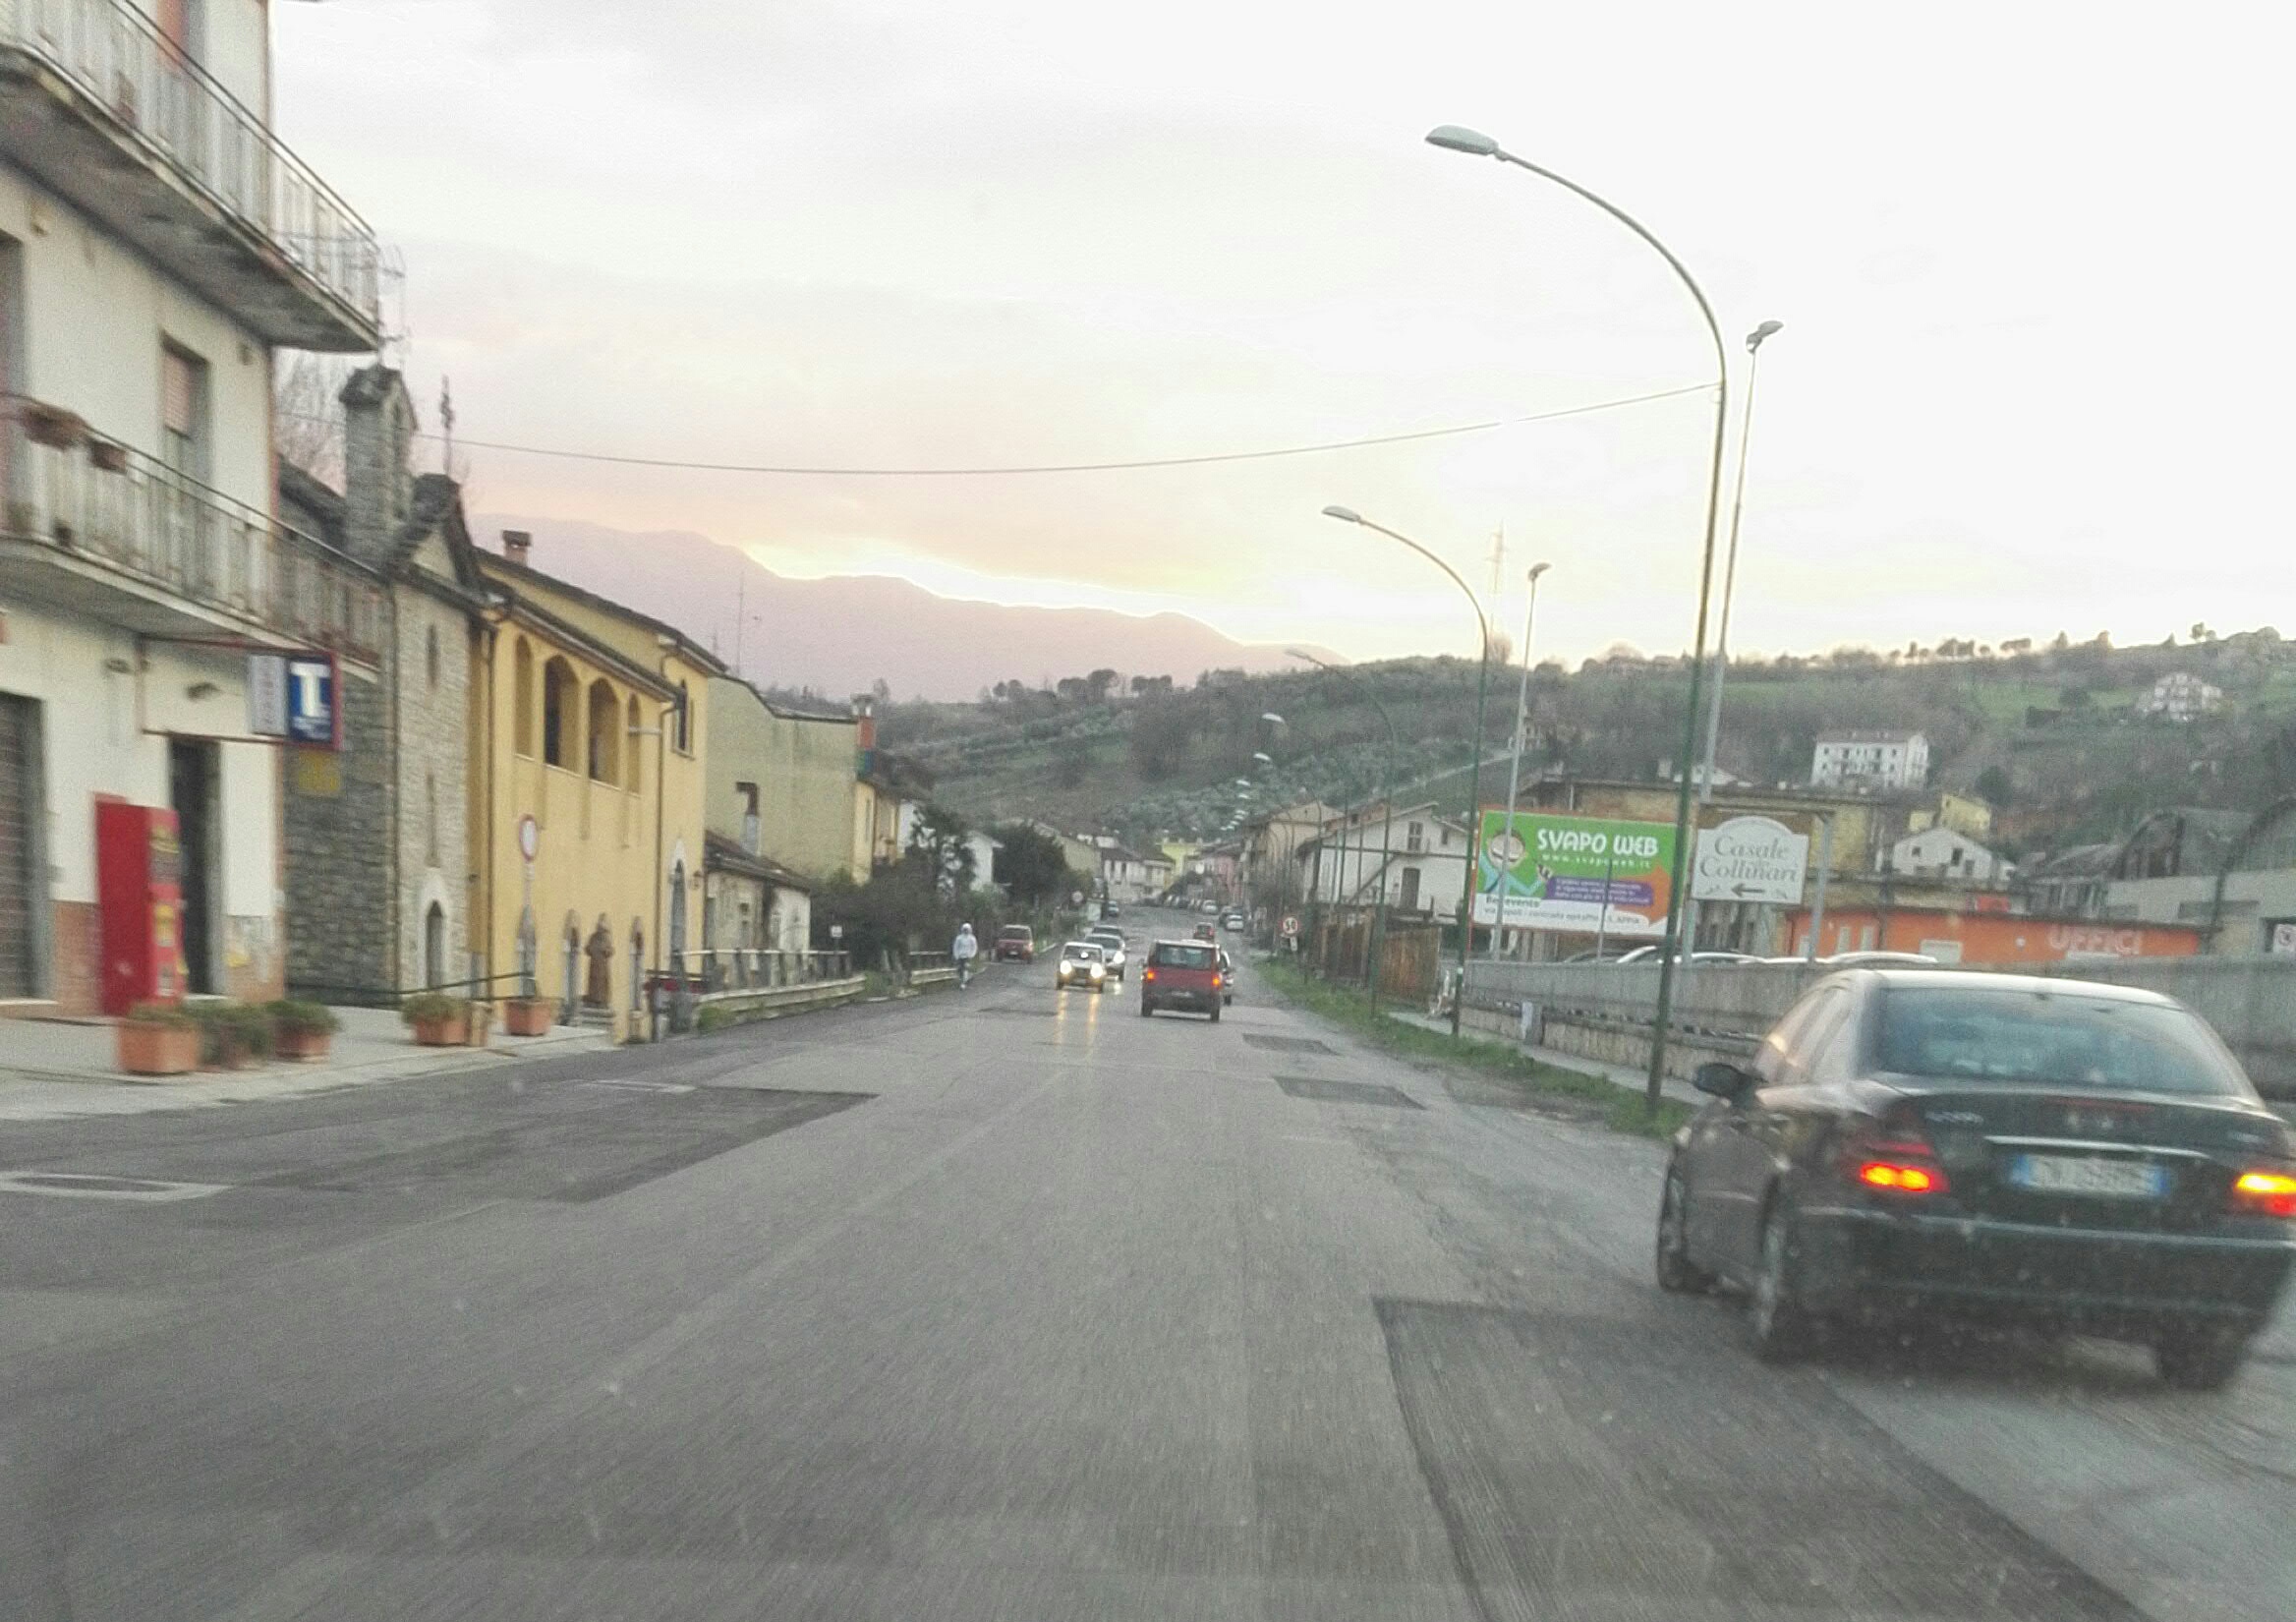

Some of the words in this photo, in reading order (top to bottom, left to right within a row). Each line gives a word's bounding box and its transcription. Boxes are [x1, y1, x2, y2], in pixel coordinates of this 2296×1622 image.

[1536, 828, 1607, 853] SVAPO
[1613, 835, 1659, 857] WEB
[1714, 835, 1790, 858] Casale
[1485, 896, 1540, 908] Beevento
[2048, 924, 2143, 956] UFFICI
